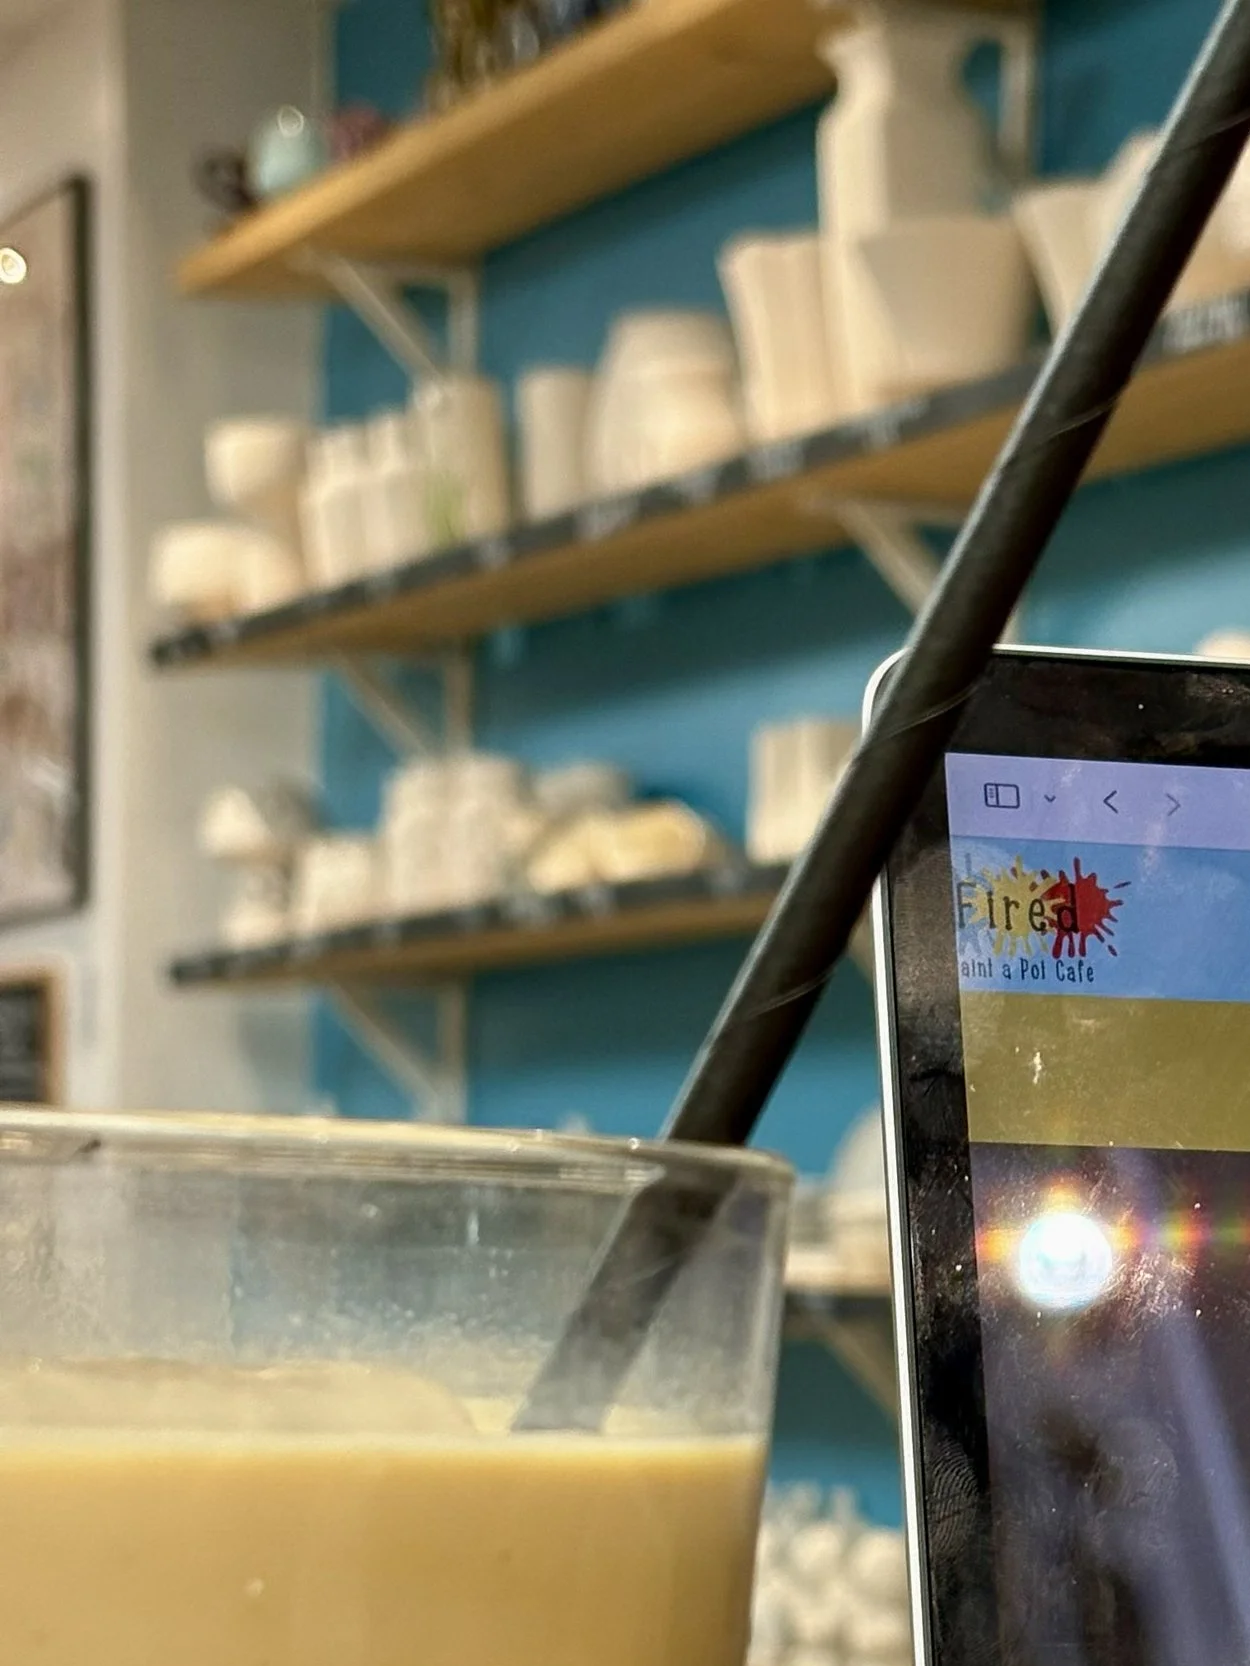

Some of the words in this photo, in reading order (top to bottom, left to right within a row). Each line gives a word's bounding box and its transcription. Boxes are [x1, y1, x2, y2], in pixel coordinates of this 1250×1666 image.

[957, 881, 1080, 934] Fired
[1002, 962, 1012, 980] a
[1055, 958, 1095, 983] Cafe
